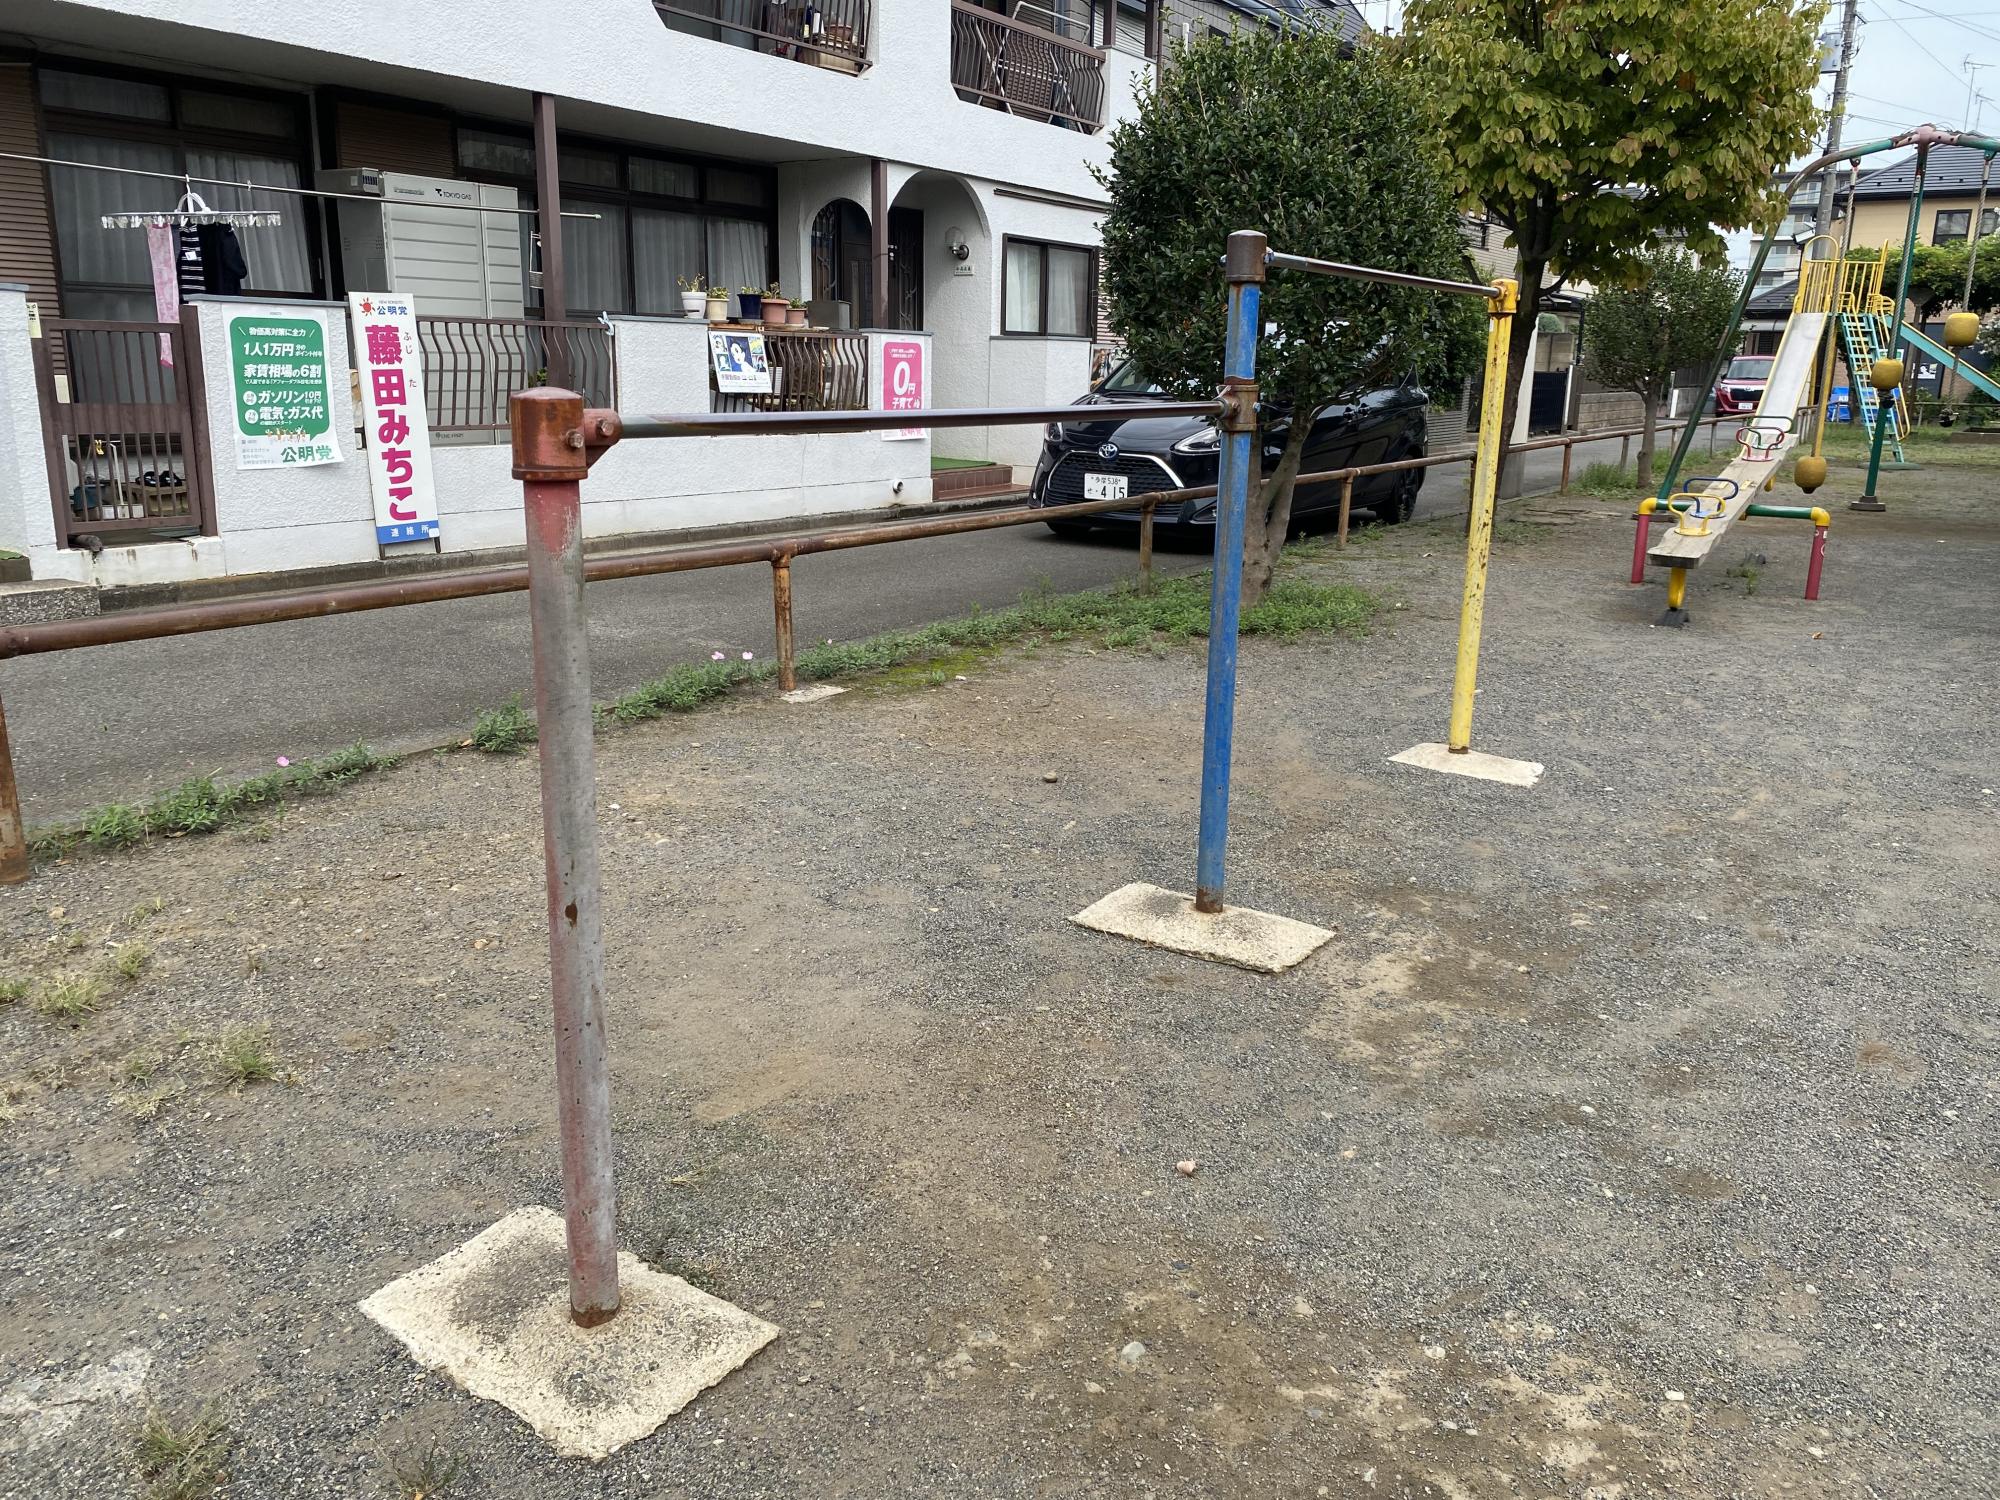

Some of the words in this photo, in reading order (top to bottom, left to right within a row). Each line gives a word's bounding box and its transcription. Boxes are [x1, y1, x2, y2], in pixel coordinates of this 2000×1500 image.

[376, 305, 408, 316] 公明党
[244, 342, 294, 356] 1人1万円
[244, 364, 322, 378] 家賃相場の6割
[258, 390, 304, 404] ガソリン
[365, 325, 417, 521] 藤田みちこ
[281, 445, 334, 463] 公明党
[390, 524, 430, 537] 連絡所
